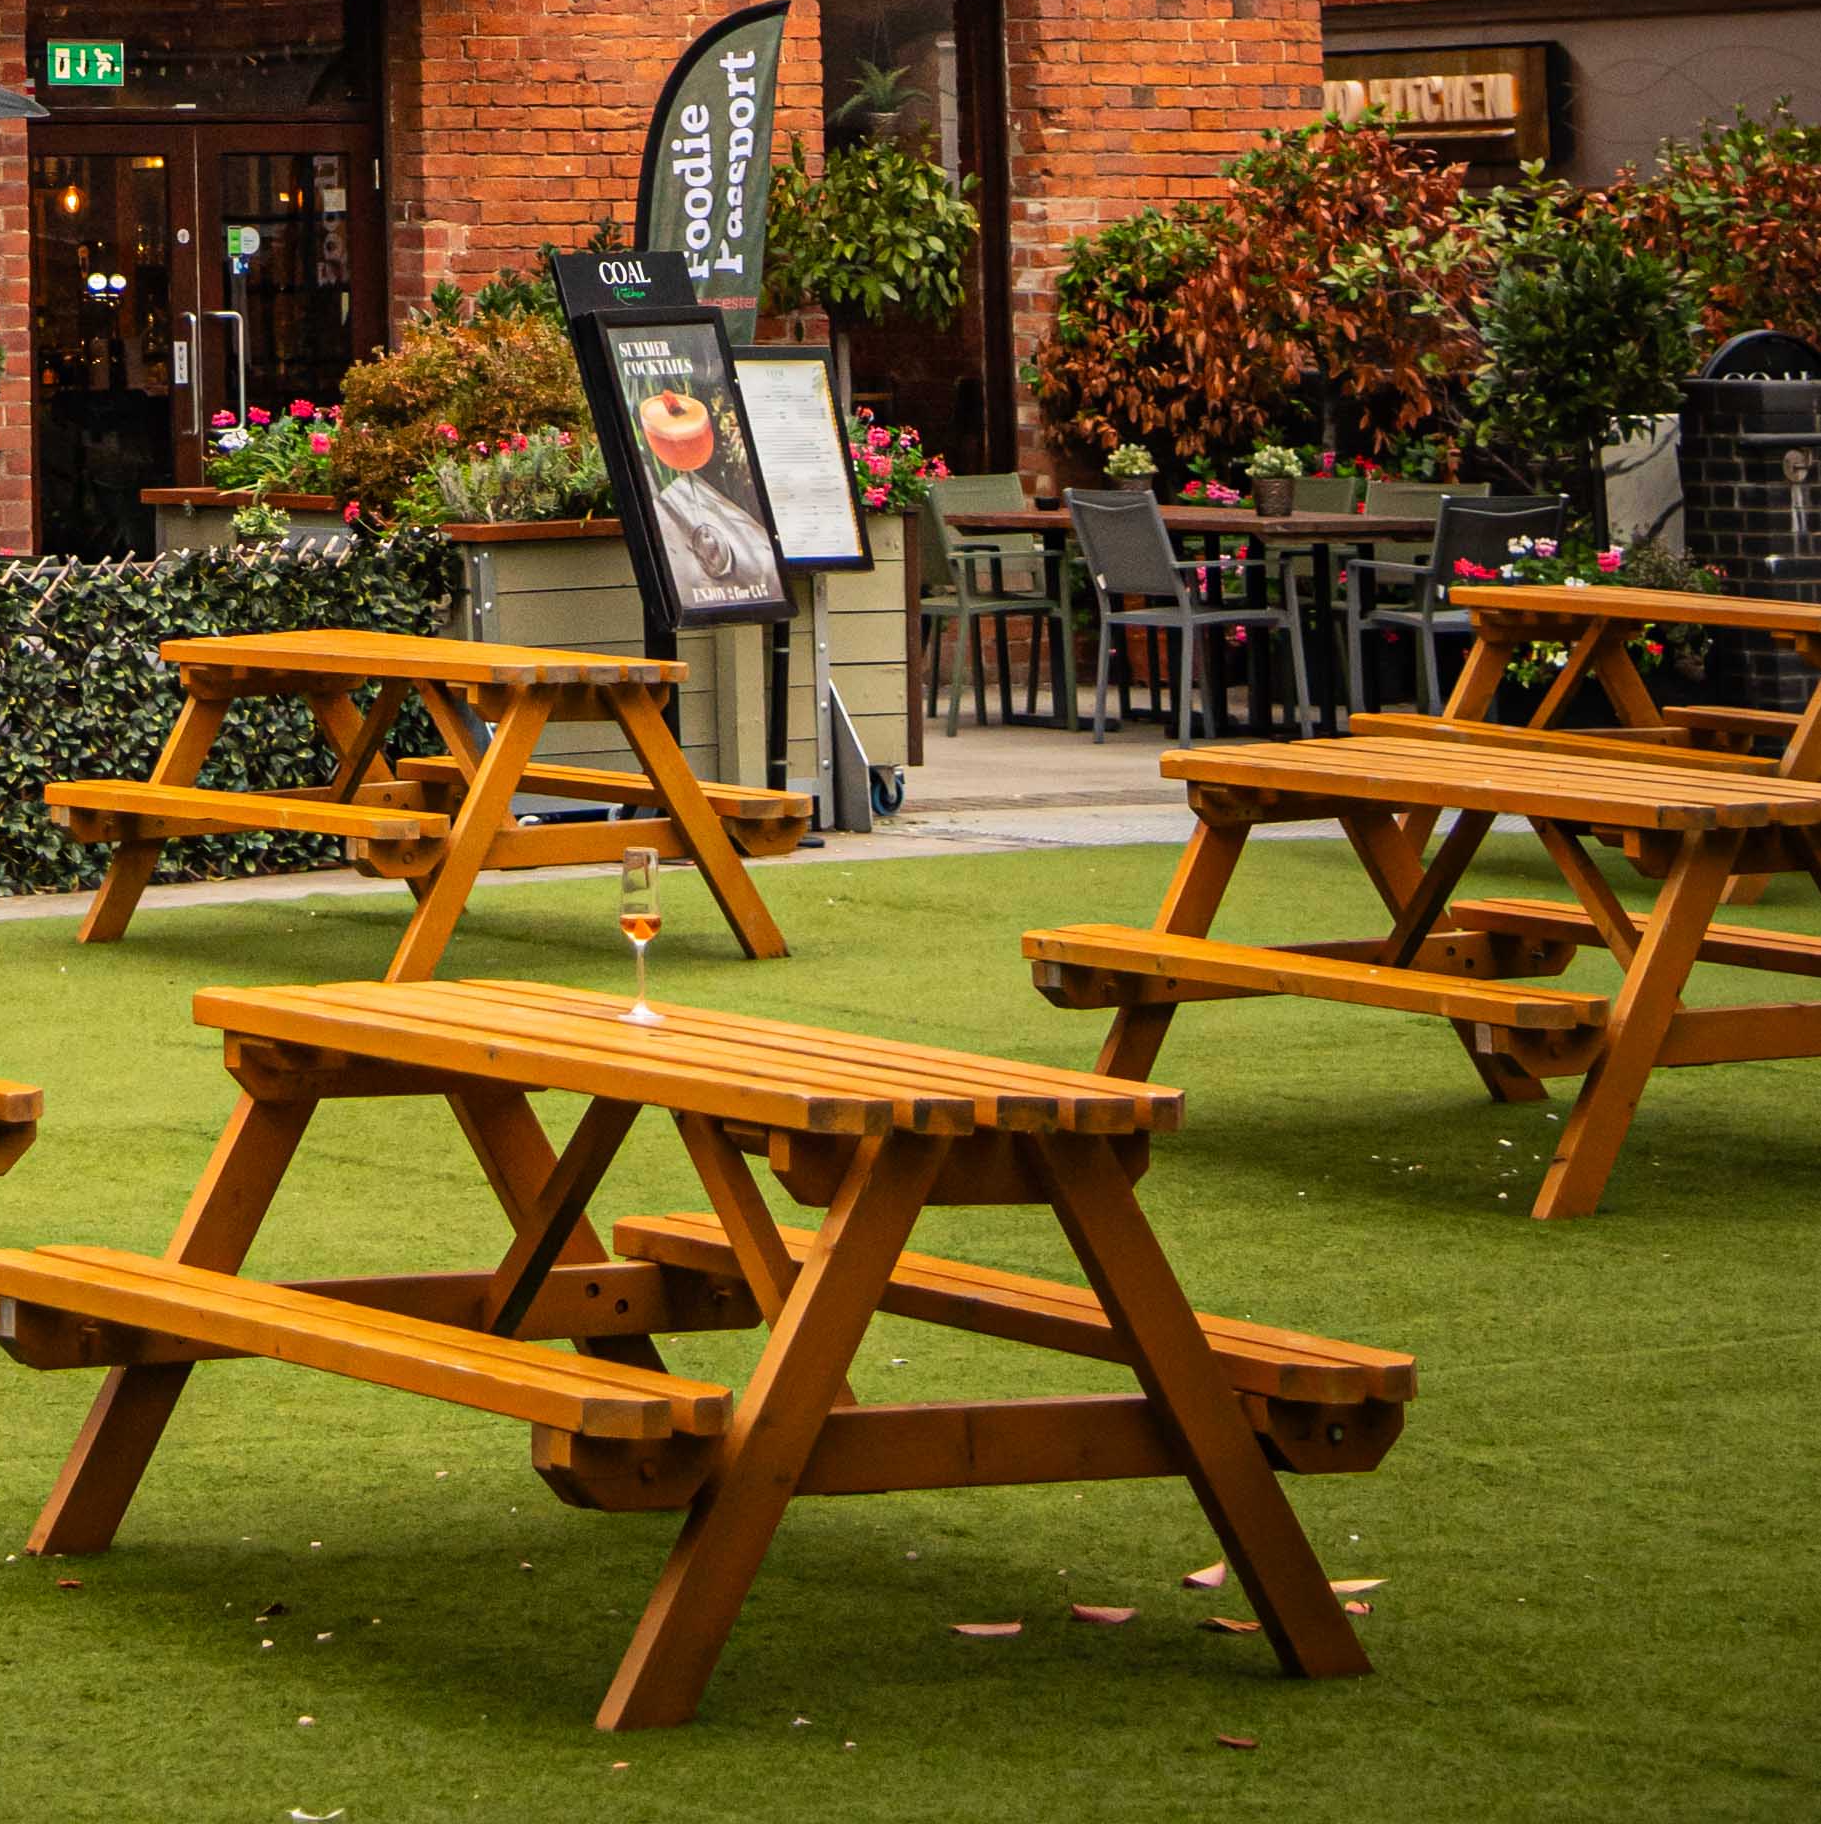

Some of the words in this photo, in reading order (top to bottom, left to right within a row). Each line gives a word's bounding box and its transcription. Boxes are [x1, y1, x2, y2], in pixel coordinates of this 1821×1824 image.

[598, 260, 652, 285] COAL
[618, 341, 671, 358] SUMMER
[623, 358, 694, 377] COCKTAILS
